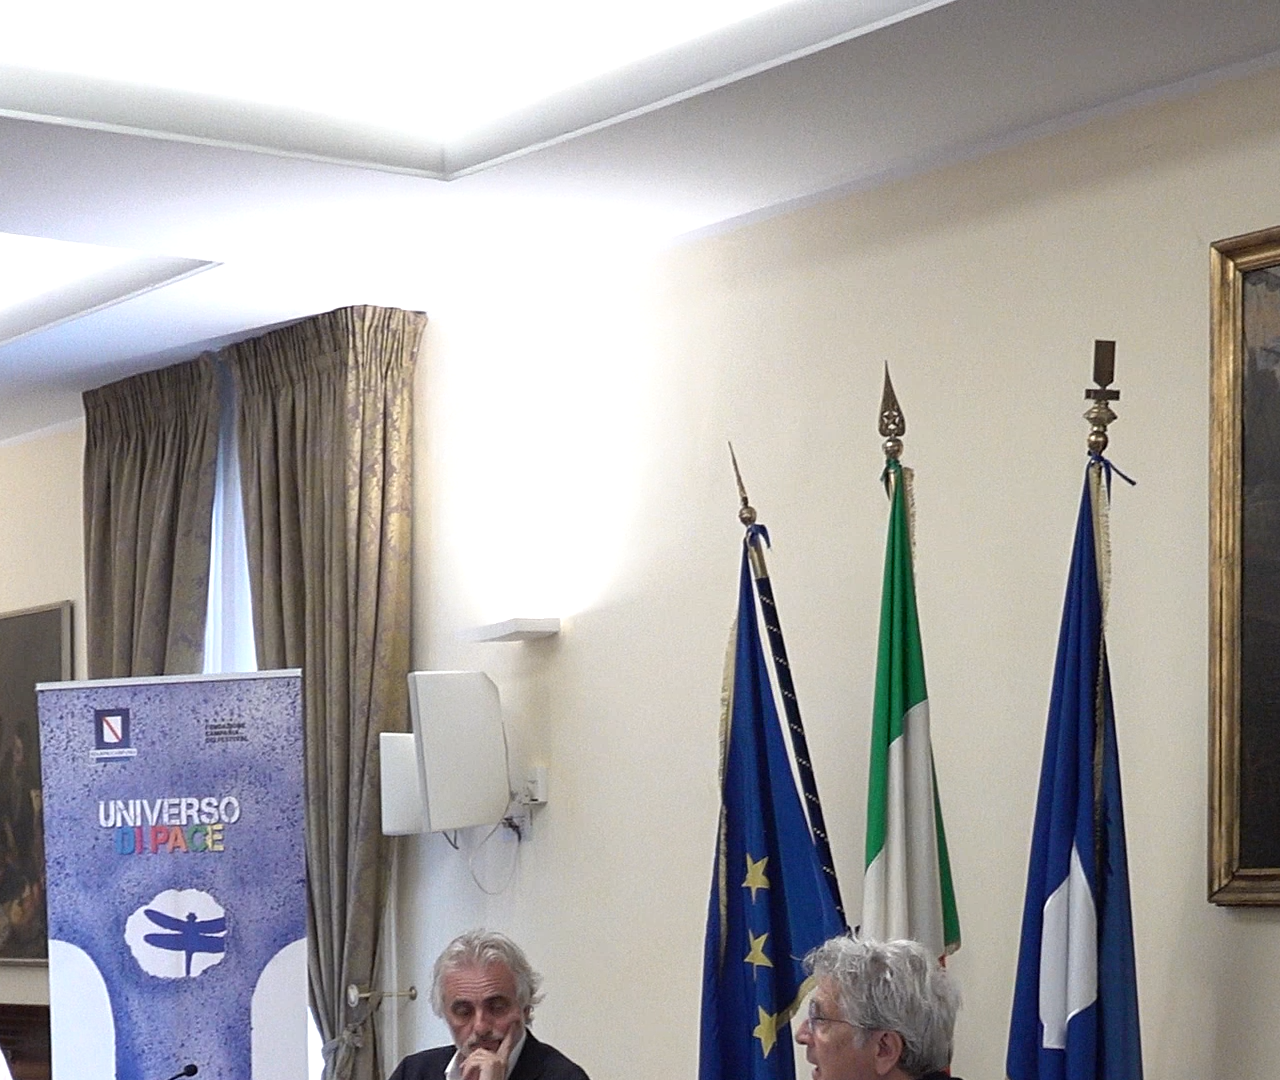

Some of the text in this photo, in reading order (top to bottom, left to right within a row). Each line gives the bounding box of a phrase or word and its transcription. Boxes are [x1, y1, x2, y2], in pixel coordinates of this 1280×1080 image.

[99, 797, 241, 827] UNIVERSO
[116, 824, 225, 855] DI PACE
